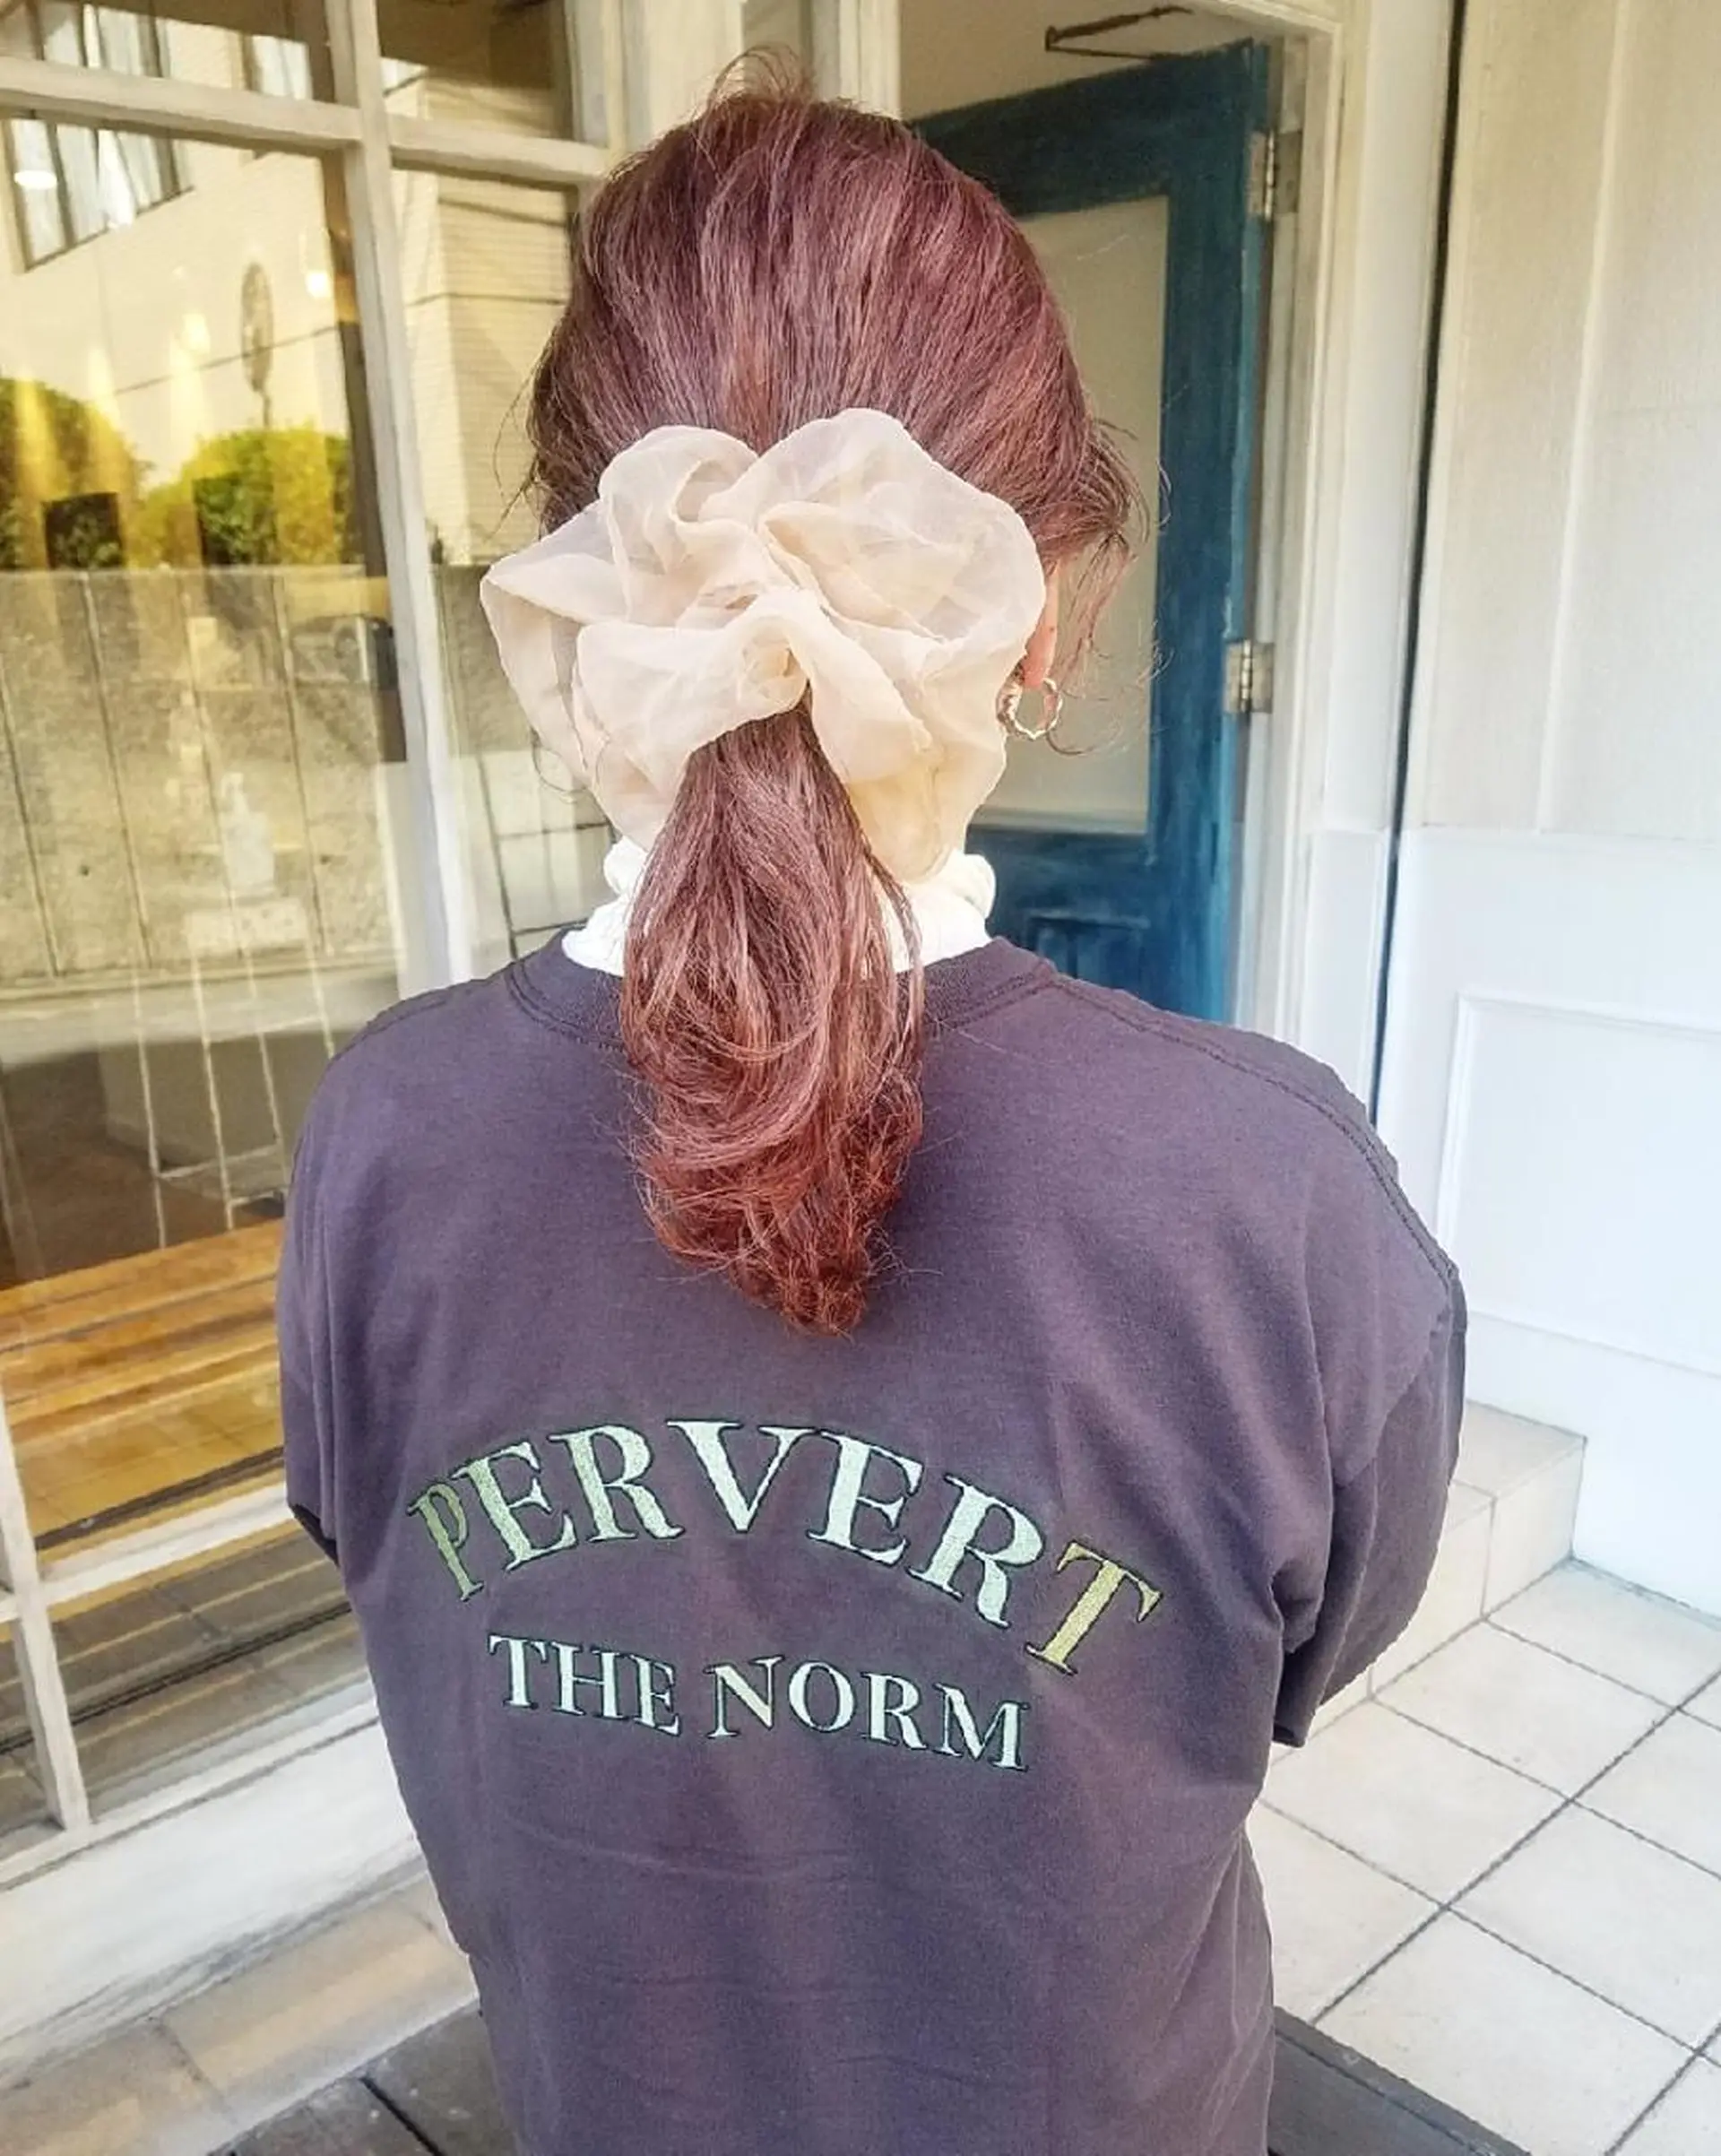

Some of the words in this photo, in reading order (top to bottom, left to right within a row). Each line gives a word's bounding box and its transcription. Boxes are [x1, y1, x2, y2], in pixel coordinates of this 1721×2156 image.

[407, 1420, 1163, 1675] PERVERT
[488, 1633, 680, 1736] THE
[705, 1656, 1031, 1771] NORM
